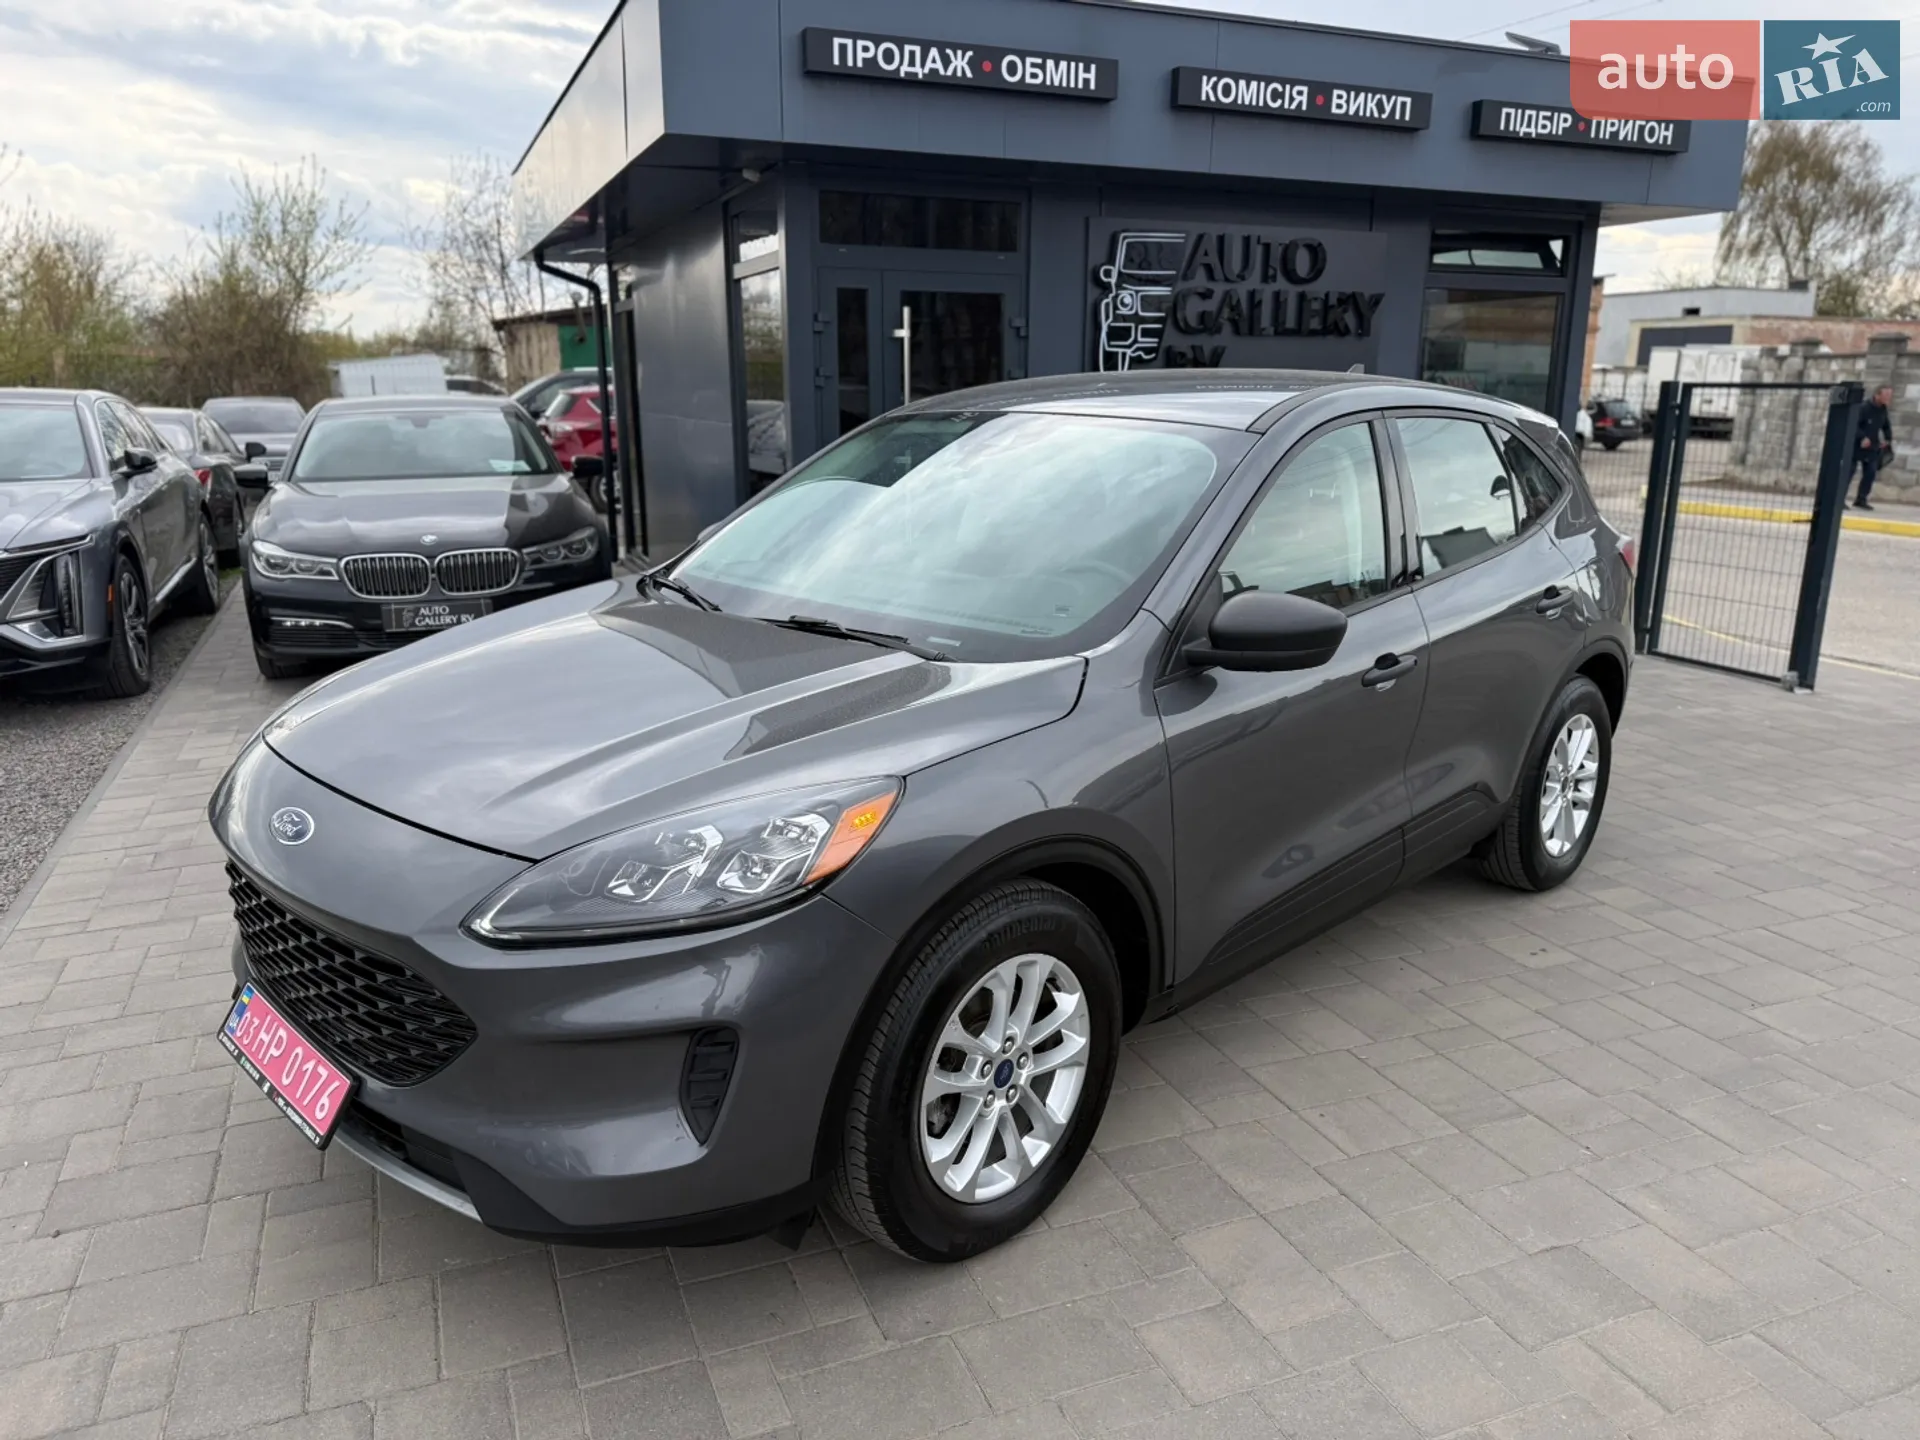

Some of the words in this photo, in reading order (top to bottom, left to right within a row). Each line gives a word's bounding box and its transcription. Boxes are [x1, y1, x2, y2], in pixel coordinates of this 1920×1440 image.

[832, 37, 974, 79] ПРОДАЖ
[1001, 54, 1096, 90] ОБМІН
[1201, 75, 1309, 111] КОМІСІЯ
[1331, 89, 1412, 121] ВИКУП
[1500, 107, 1573, 137] ПІДБІР
[1590, 116, 1674, 145] ПРИГОН
[1181, 232, 1327, 285] AUTO
[1172, 286, 1385, 337] GALLERY
[415, 616, 458, 626] GALLERY
[419, 606, 449, 615] AUTO
[273, 812, 302, 837] Ford
[282, 1046, 340, 1120] 0176
